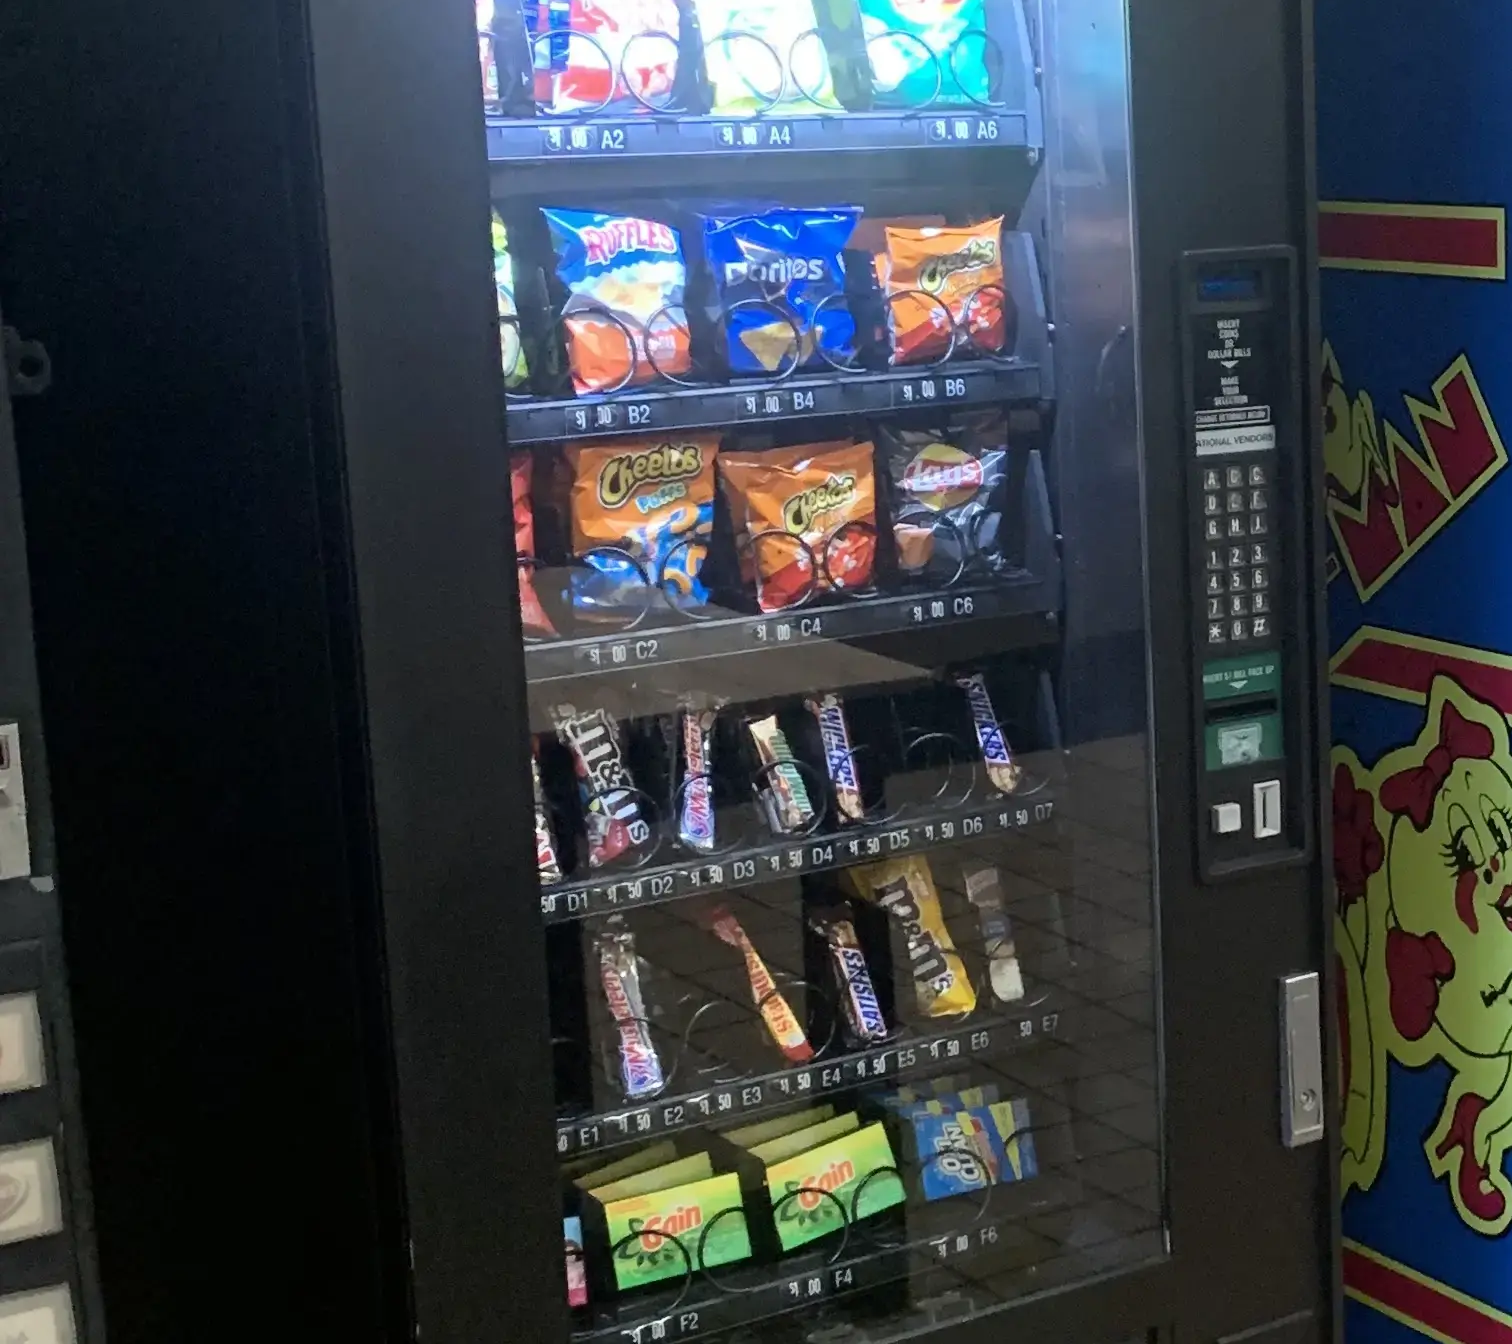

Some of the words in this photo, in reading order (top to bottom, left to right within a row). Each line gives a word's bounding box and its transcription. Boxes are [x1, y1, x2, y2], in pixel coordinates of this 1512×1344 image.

[601, 129, 625, 150] A2
[769, 126, 791, 145] A4
[977, 120, 998, 140] A6
[583, 217, 678, 266] RUFFLES
[724, 257, 824, 287] Doritos
[945, 378, 966, 397] B6
[792, 391, 815, 411] B4
[627, 404, 652, 425] B2
[1195, 435, 1232, 447] ATIONAL
[1233, 431, 1274, 444] VENDORS
[599, 443, 702, 509] Cheetos
[1208, 471, 1215, 485] A
[780, 475, 857, 535] Cheetos
[1209, 520, 1217, 535] G
[1231, 517, 1240, 532] H
[1211, 550, 1217, 565] 1
[1232, 548, 1239, 563] 2
[1255, 545, 1262, 560] 3
[1210, 576, 1218, 589] 4
[1233, 572, 1240, 587] 5
[1255, 570, 1262, 584] 6
[953, 597, 973, 616] C6
[1211, 599, 1218, 614] 7
[1233, 597, 1240, 611] 8
[1256, 593, 1263, 608] 9
[800, 616, 823, 637] C4
[635, 640, 659, 660] C2
[962, 816, 983, 836] D6
[889, 828, 910, 850] D5
[812, 847, 833, 866] D4
[733, 860, 756, 881] D3
[651, 876, 674, 897] D2
[567, 892, 588, 912] D1
[1042, 1014, 1059, 1036] E7
[971, 1031, 989, 1051] E6
[898, 1049, 916, 1069] E5
[822, 1067, 841, 1087] E4
[742, 1086, 762, 1106] E3
[663, 1106, 684, 1126] E2
[580, 1127, 599, 1147] E1
[799, 1160, 854, 1210] Gain
[639, 1205, 702, 1250] Gain
[980, 1226, 998, 1245] F6
[835, 1269, 853, 1288] F4
[680, 1312, 699, 1332] F2
